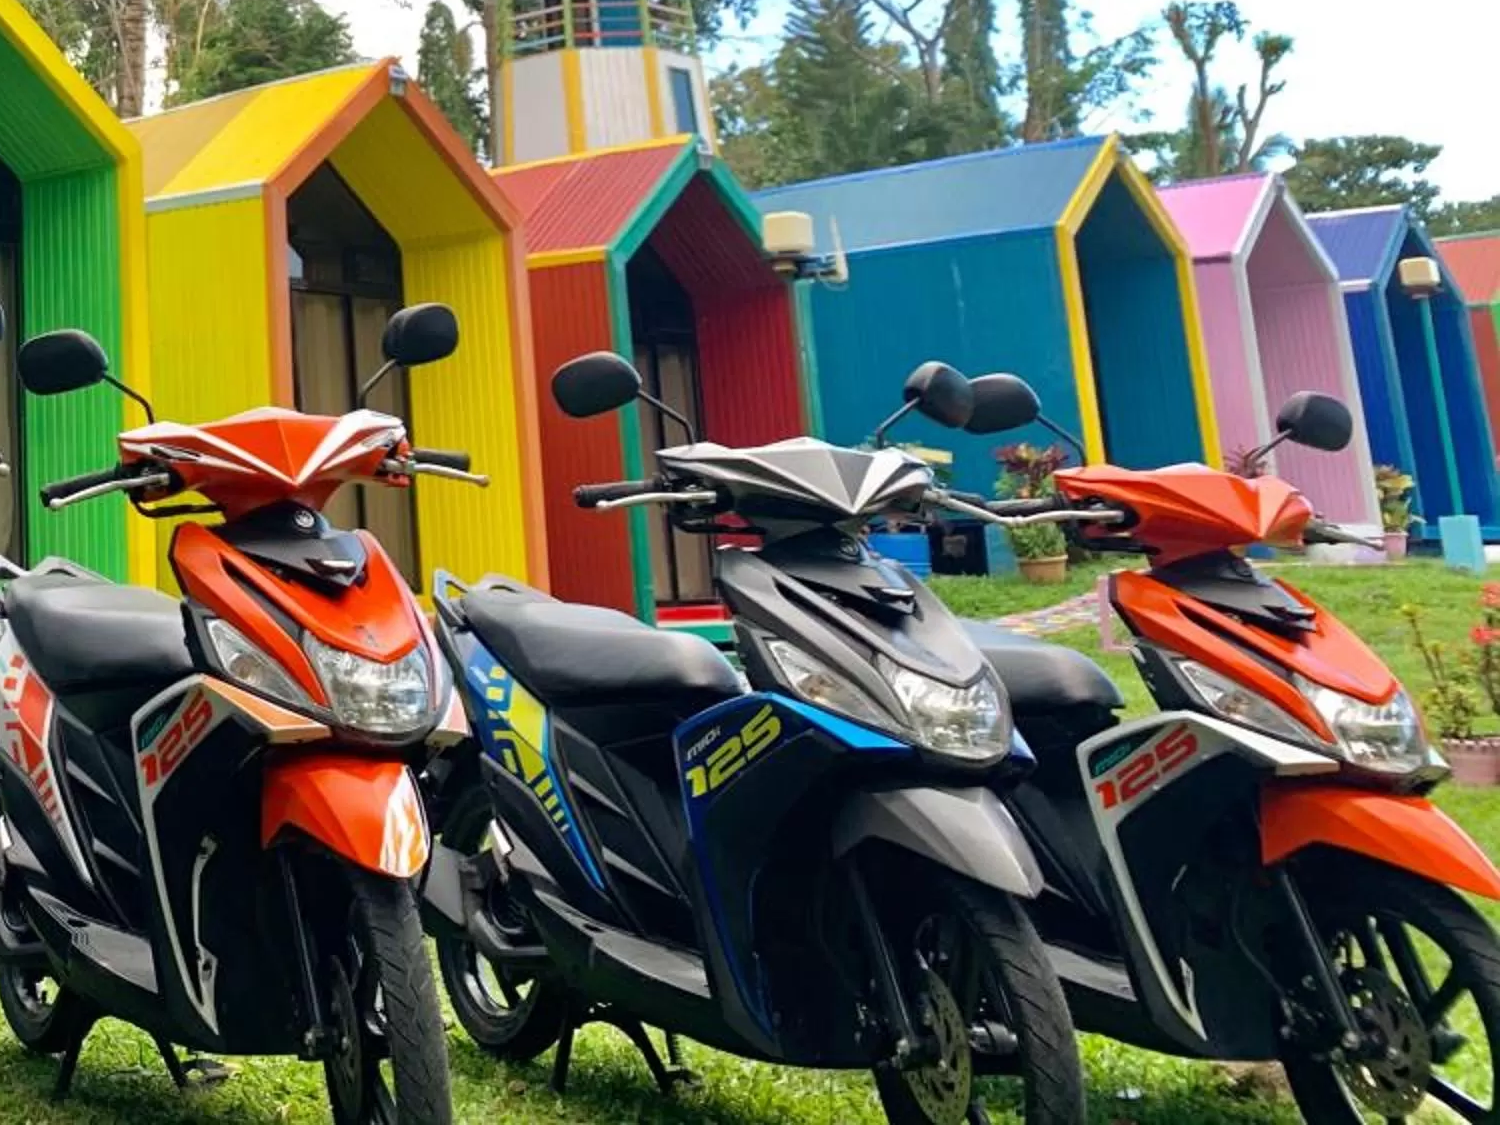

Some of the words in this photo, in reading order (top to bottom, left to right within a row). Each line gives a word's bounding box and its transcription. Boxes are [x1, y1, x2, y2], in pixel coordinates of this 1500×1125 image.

[141, 687, 214, 788] 125
[685, 703, 782, 798] 125
[1095, 722, 1198, 810] 125
